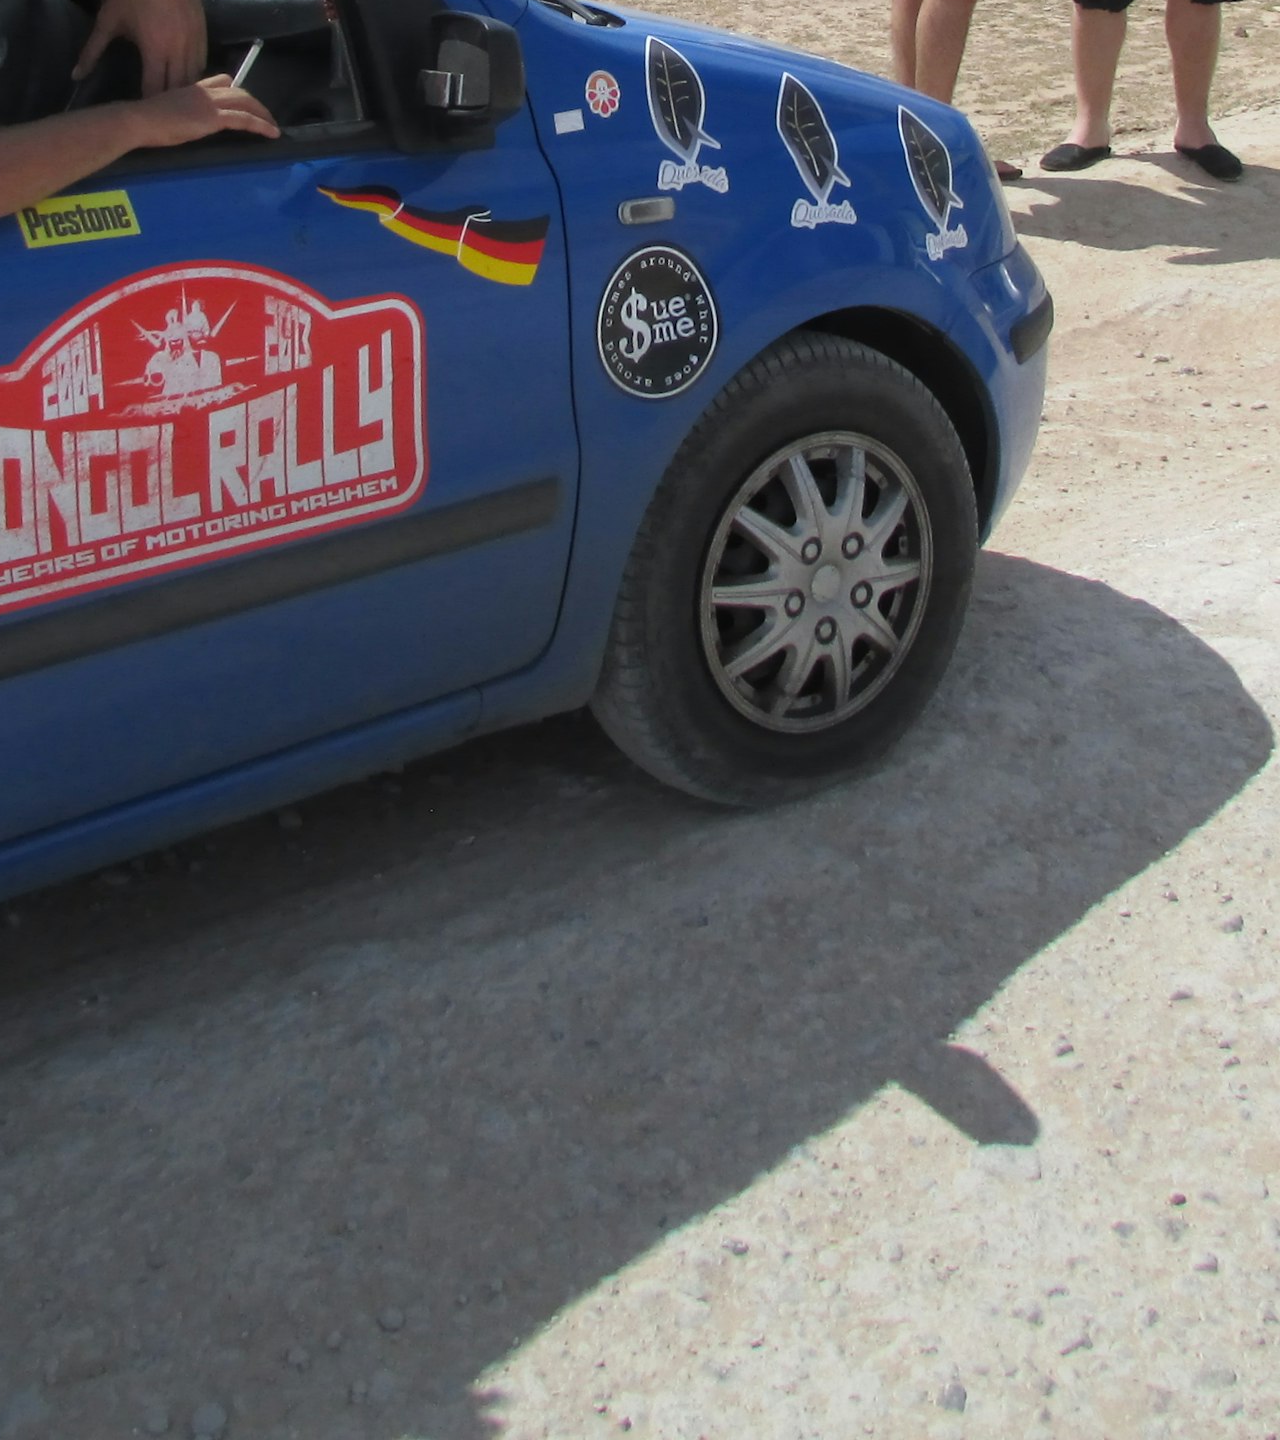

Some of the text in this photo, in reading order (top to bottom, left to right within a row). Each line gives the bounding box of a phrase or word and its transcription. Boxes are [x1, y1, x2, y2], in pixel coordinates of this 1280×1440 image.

[25, 198, 133, 241] Prestone
[42, 322, 104, 421] 2004
[264, 295, 312, 376] 2013
[652, 317, 696, 344] me
[208, 330, 395, 513] RALLY
[100, 538, 139, 562] OF
[145, 503, 286, 552] MOTORING
[290, 476, 398, 514] MAYHEM
